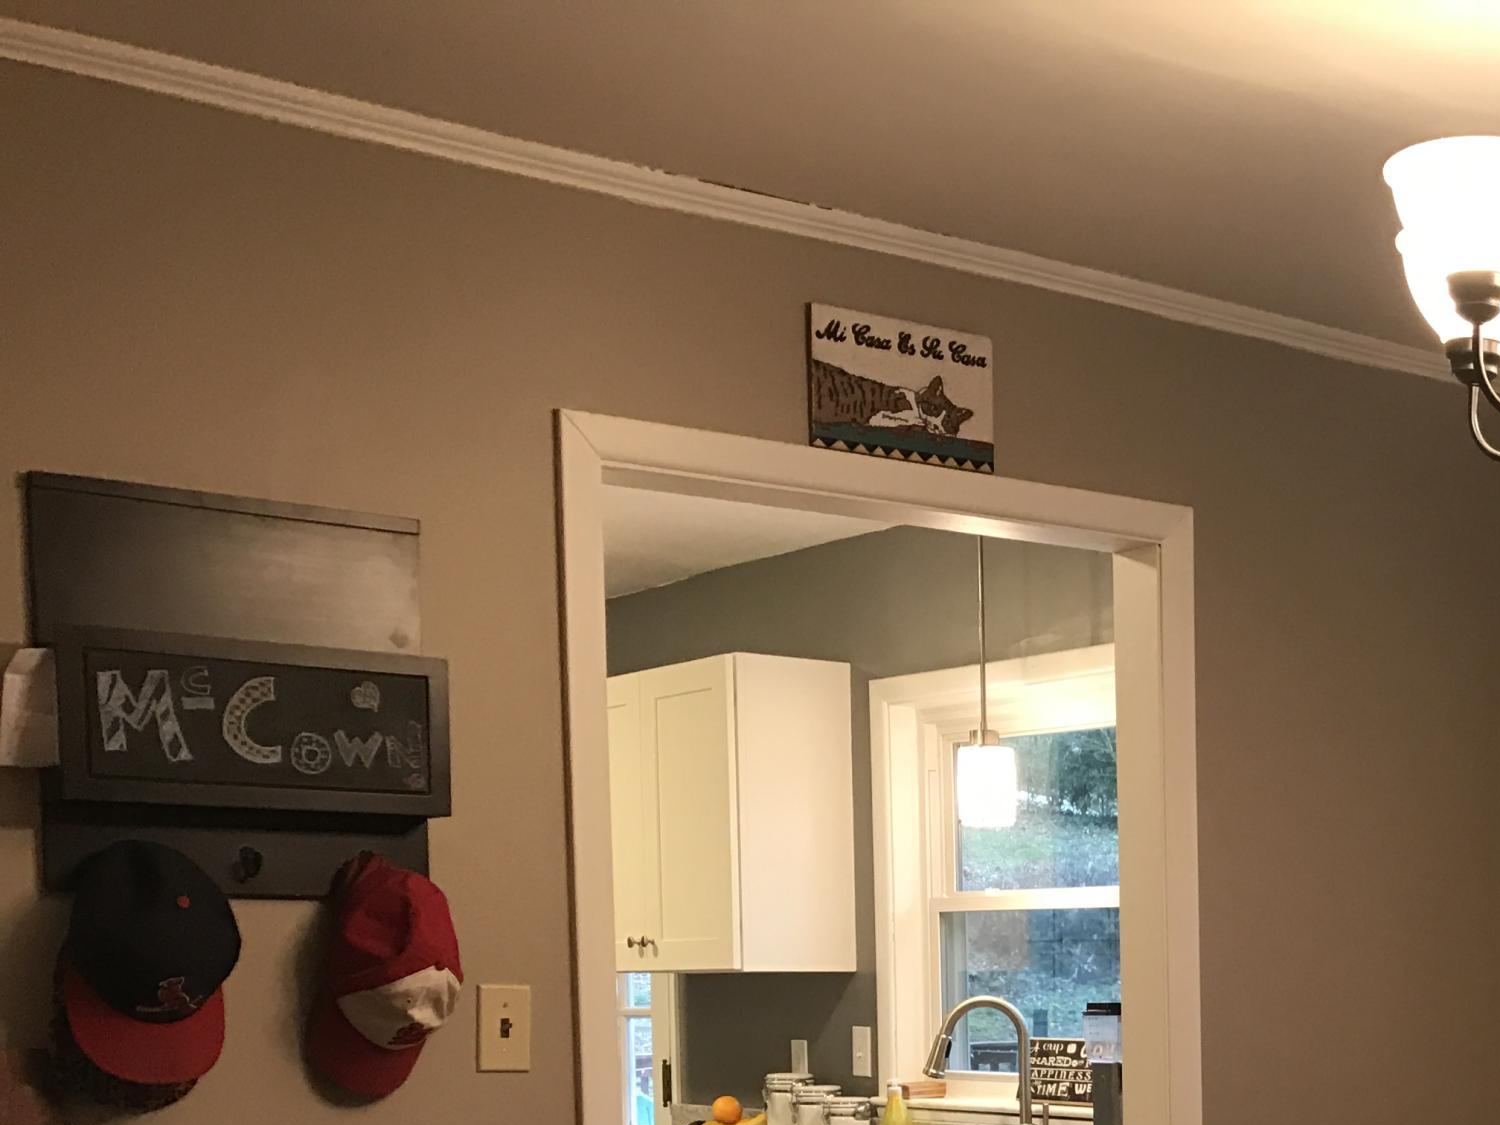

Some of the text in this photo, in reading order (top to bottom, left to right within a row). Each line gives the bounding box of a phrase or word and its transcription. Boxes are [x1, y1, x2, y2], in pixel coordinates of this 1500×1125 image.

[815, 319, 847, 343] Mi
[851, 322, 892, 351] Casa
[920, 335, 944, 361] Su
[948, 340, 988, 368] Casa
[1043, 1043, 1064, 1055] cup
[1032, 1070, 1092, 1081] APPINESS
[1037, 1081, 1070, 1097] TIME
